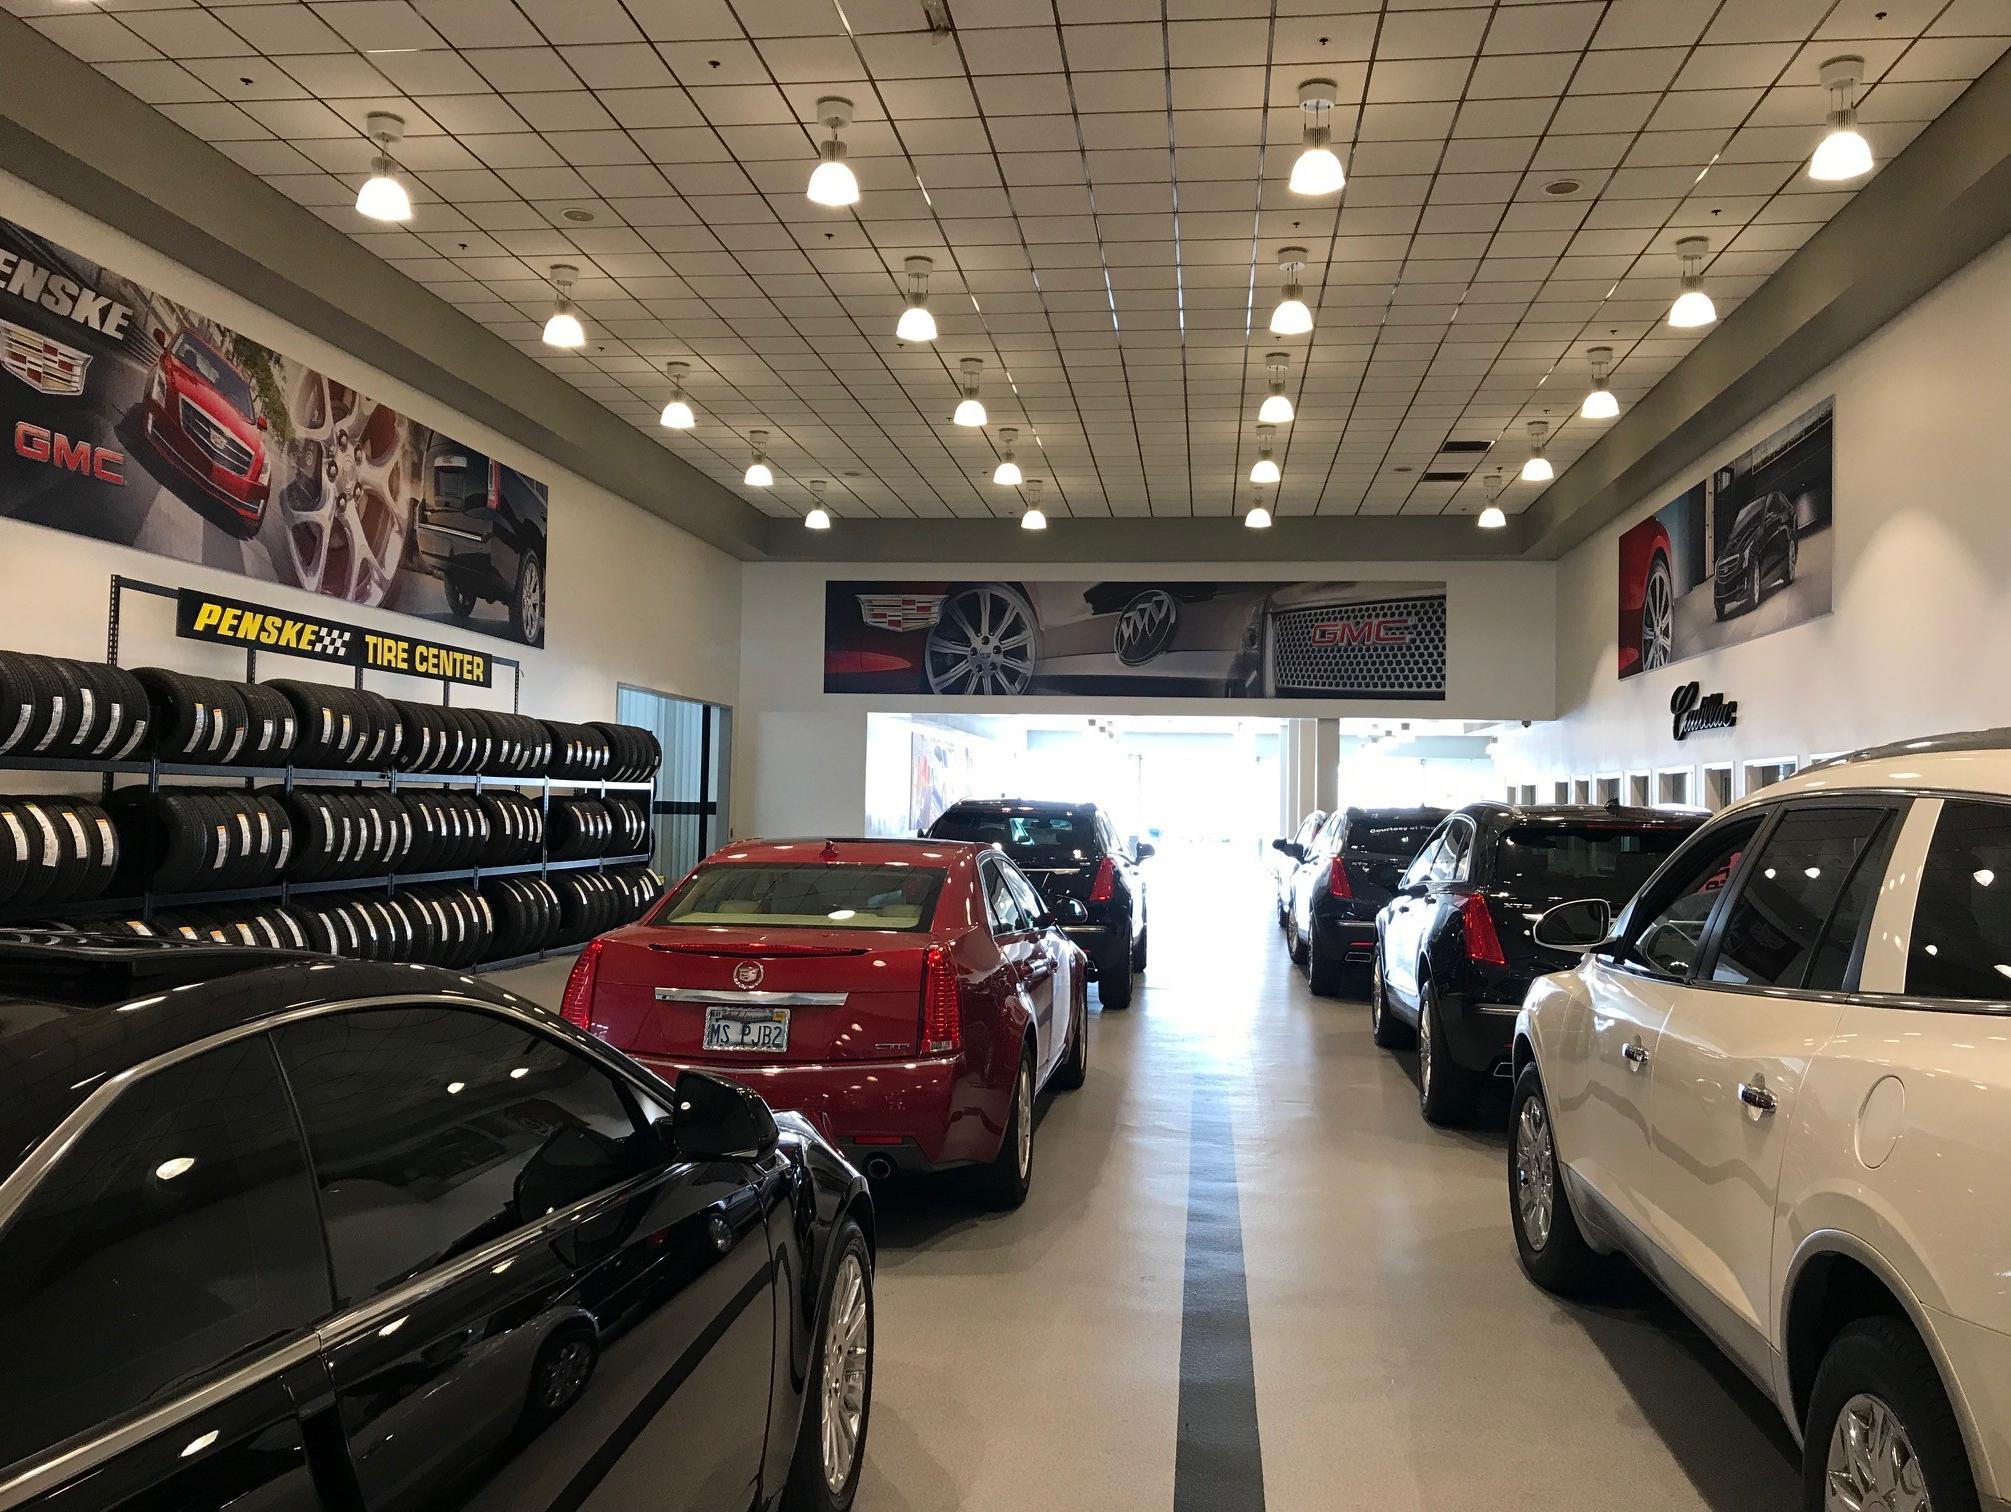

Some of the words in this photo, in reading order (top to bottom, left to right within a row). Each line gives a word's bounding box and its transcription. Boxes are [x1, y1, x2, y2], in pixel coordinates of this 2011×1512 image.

[14, 421, 125, 485] GMC
[193, 602, 319, 651] PENSKE
[365, 634, 409, 669] TIRE
[415, 645, 484, 681] CENTER
[1311, 617, 1409, 646] GMC
[707, 1023, 730, 1044] MS
[741, 1024, 783, 1048] PJB2
